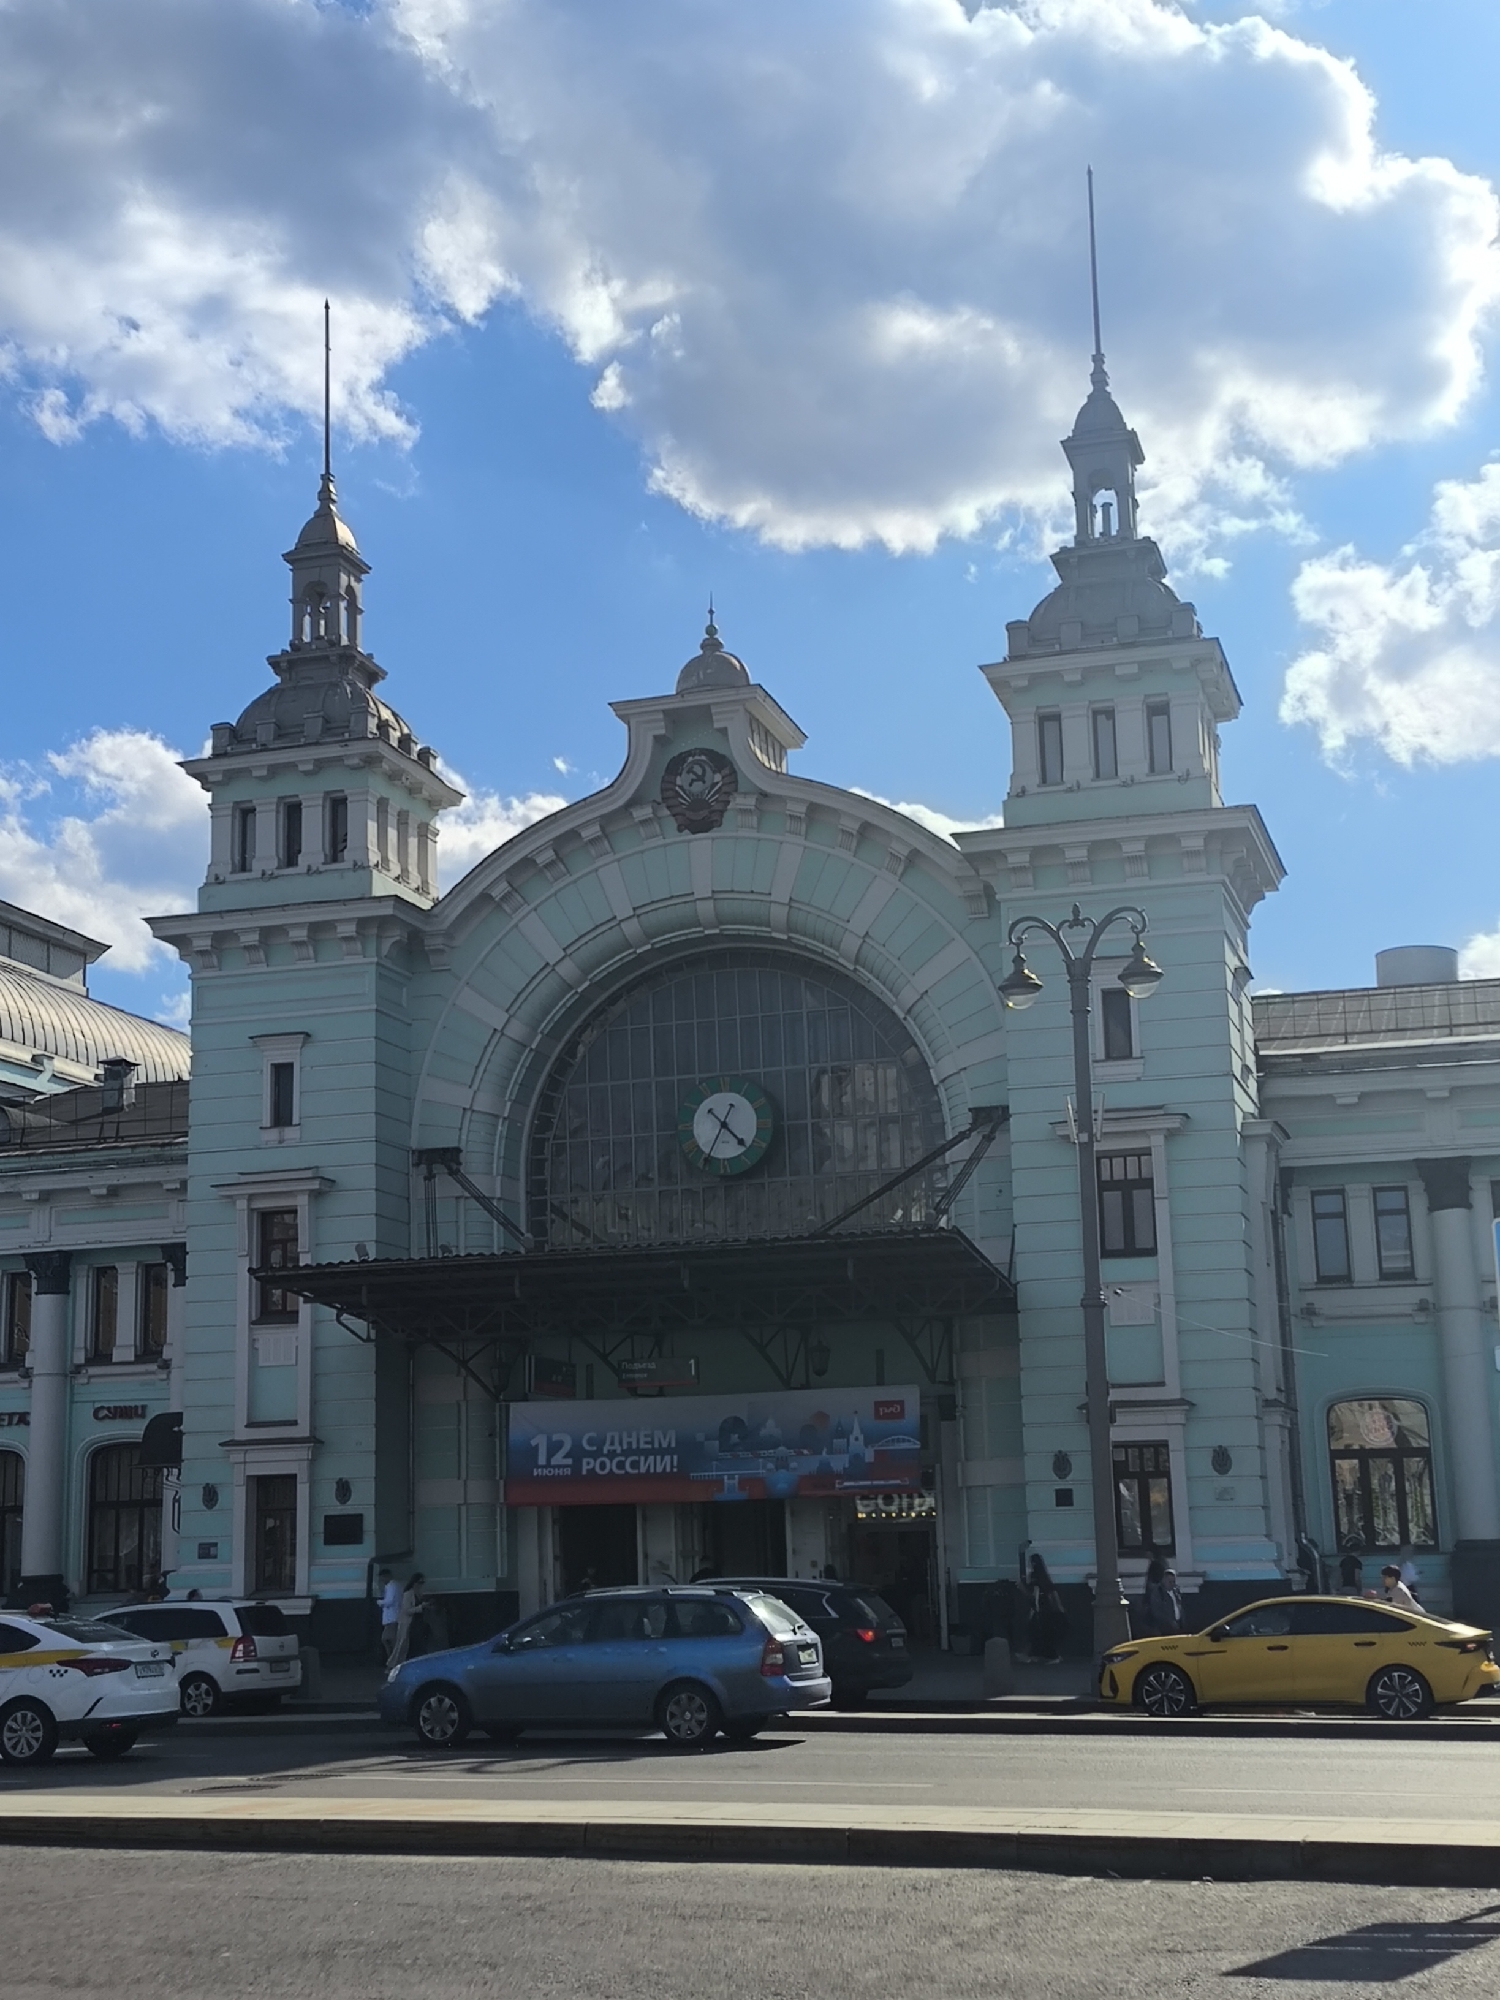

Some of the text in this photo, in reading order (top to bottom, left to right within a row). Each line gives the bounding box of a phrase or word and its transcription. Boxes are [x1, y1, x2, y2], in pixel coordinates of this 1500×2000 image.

[688, 1358, 695, 1376] 1
[93, 1404, 148, 1420] СУШИ
[530, 1433, 573, 1465] 12
[582, 1432, 597, 1451] С
[581, 1455, 678, 1475] РОССИИ!
